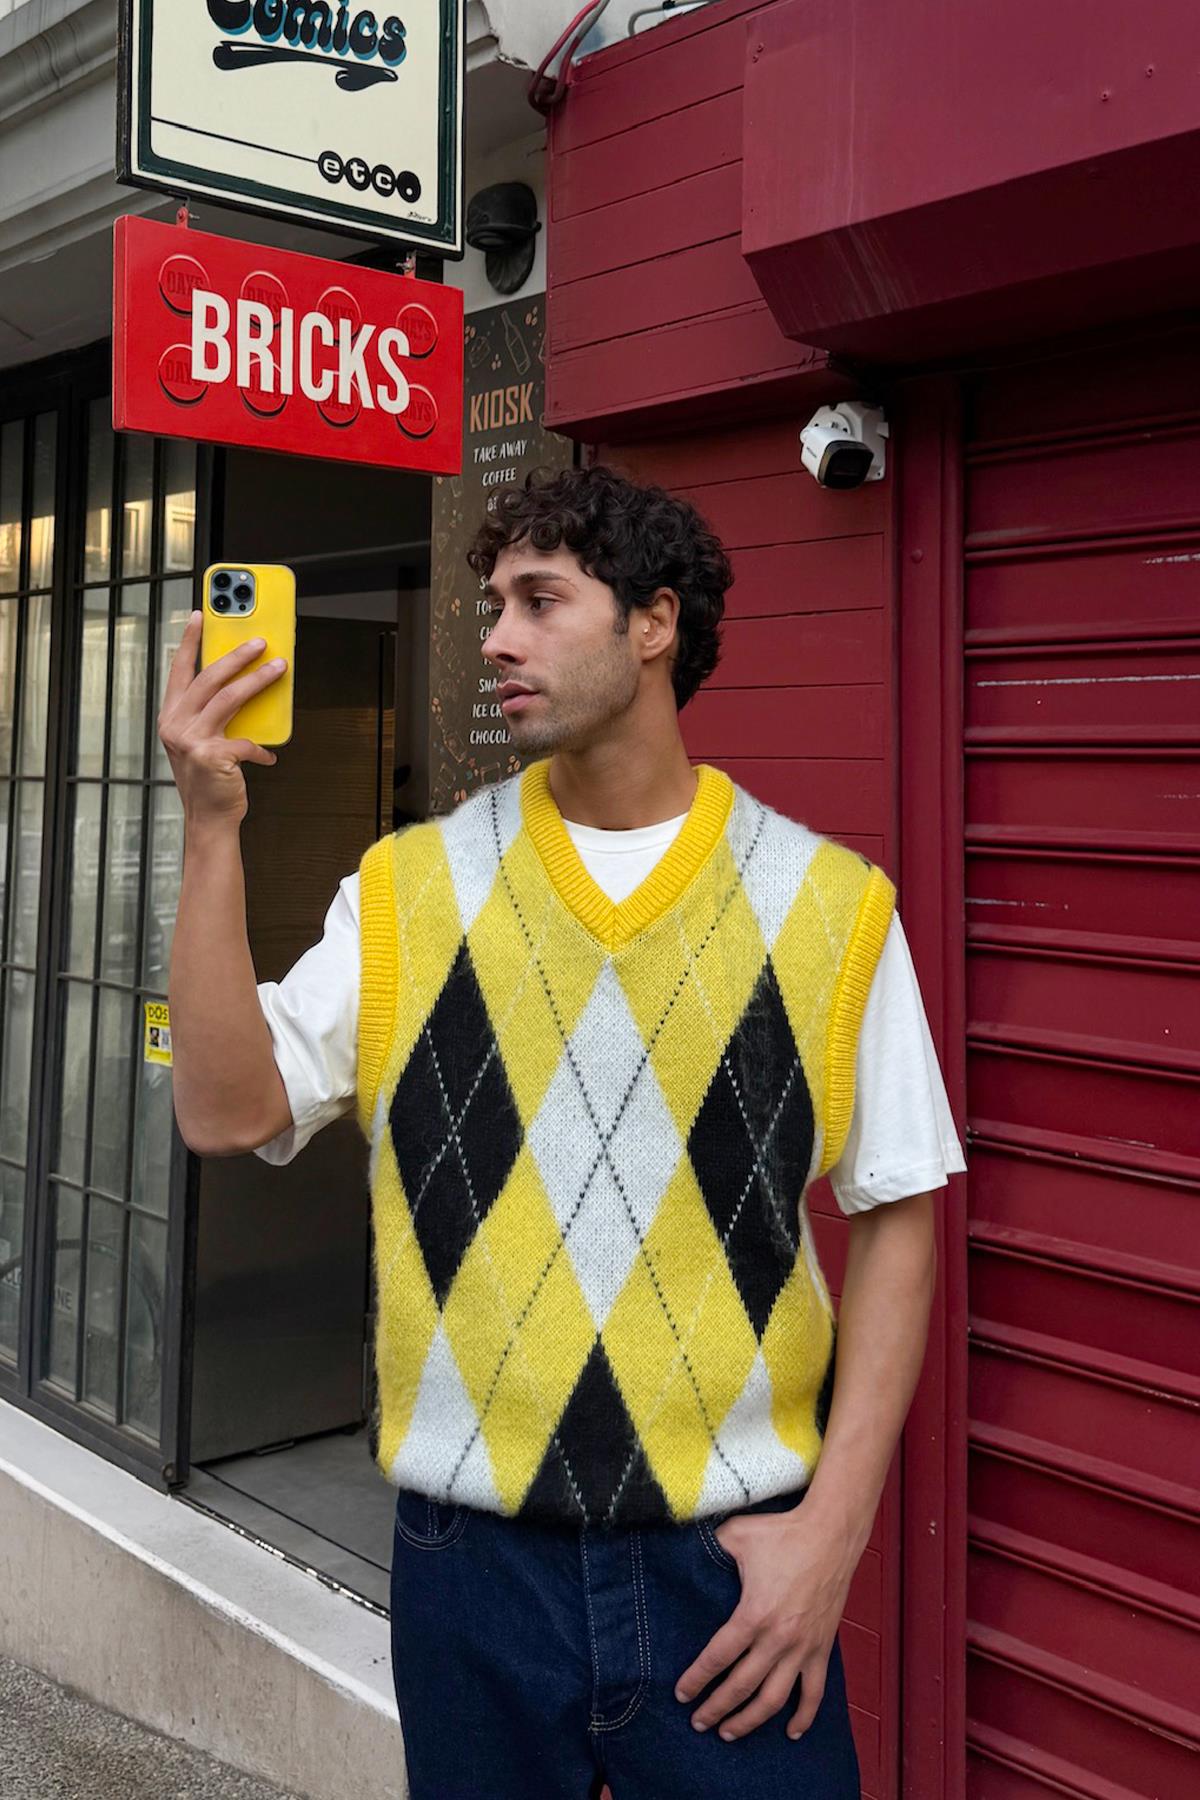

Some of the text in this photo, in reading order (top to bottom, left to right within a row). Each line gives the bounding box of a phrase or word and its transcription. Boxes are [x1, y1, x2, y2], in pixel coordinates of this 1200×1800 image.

[191, 287, 410, 415] BRICKS
[470, 382, 534, 433] KIOSK
[473, 439, 528, 463] TAKE AWAY
[482, 467, 517, 486] COFFEE
[472, 703, 488, 718] ICE
